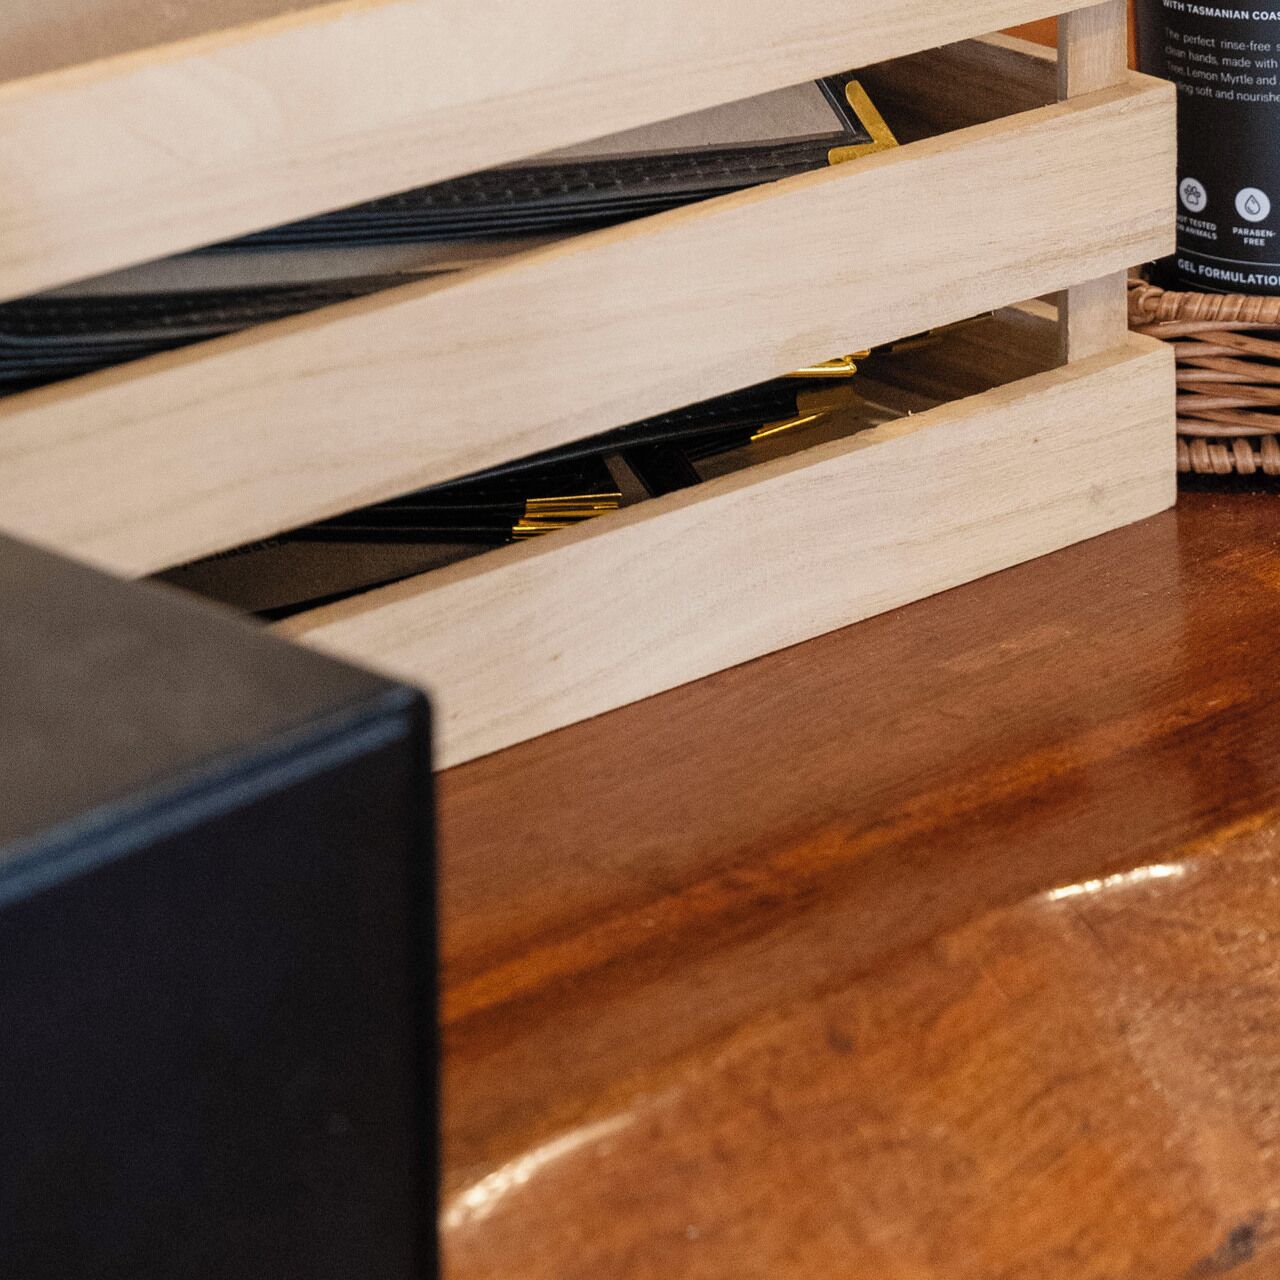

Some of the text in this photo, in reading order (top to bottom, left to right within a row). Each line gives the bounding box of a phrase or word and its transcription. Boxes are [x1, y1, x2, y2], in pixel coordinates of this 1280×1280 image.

[1186, 4, 1250, 21] TASMANIAN
[1183, 34, 1216, 48] perfect
[1220, 39, 1271, 52] rinse-free
[1221, 57, 1251, 68] made
[1255, 58, 1278, 69] with
[1186, 66, 1218, 81] Lemon
[1220, 72, 1254, 85] Myrtle
[1255, 75, 1277, 86] and
[1195, 86, 1213, 98] soft
[1215, 89, 1234, 100] and
[1189, 217, 1217, 231] TESTED
[1185, 225, 1218, 241] ANIMALS
[1243, 237, 1266, 247] FREE
[1177, 258, 1197, 274] GEL
